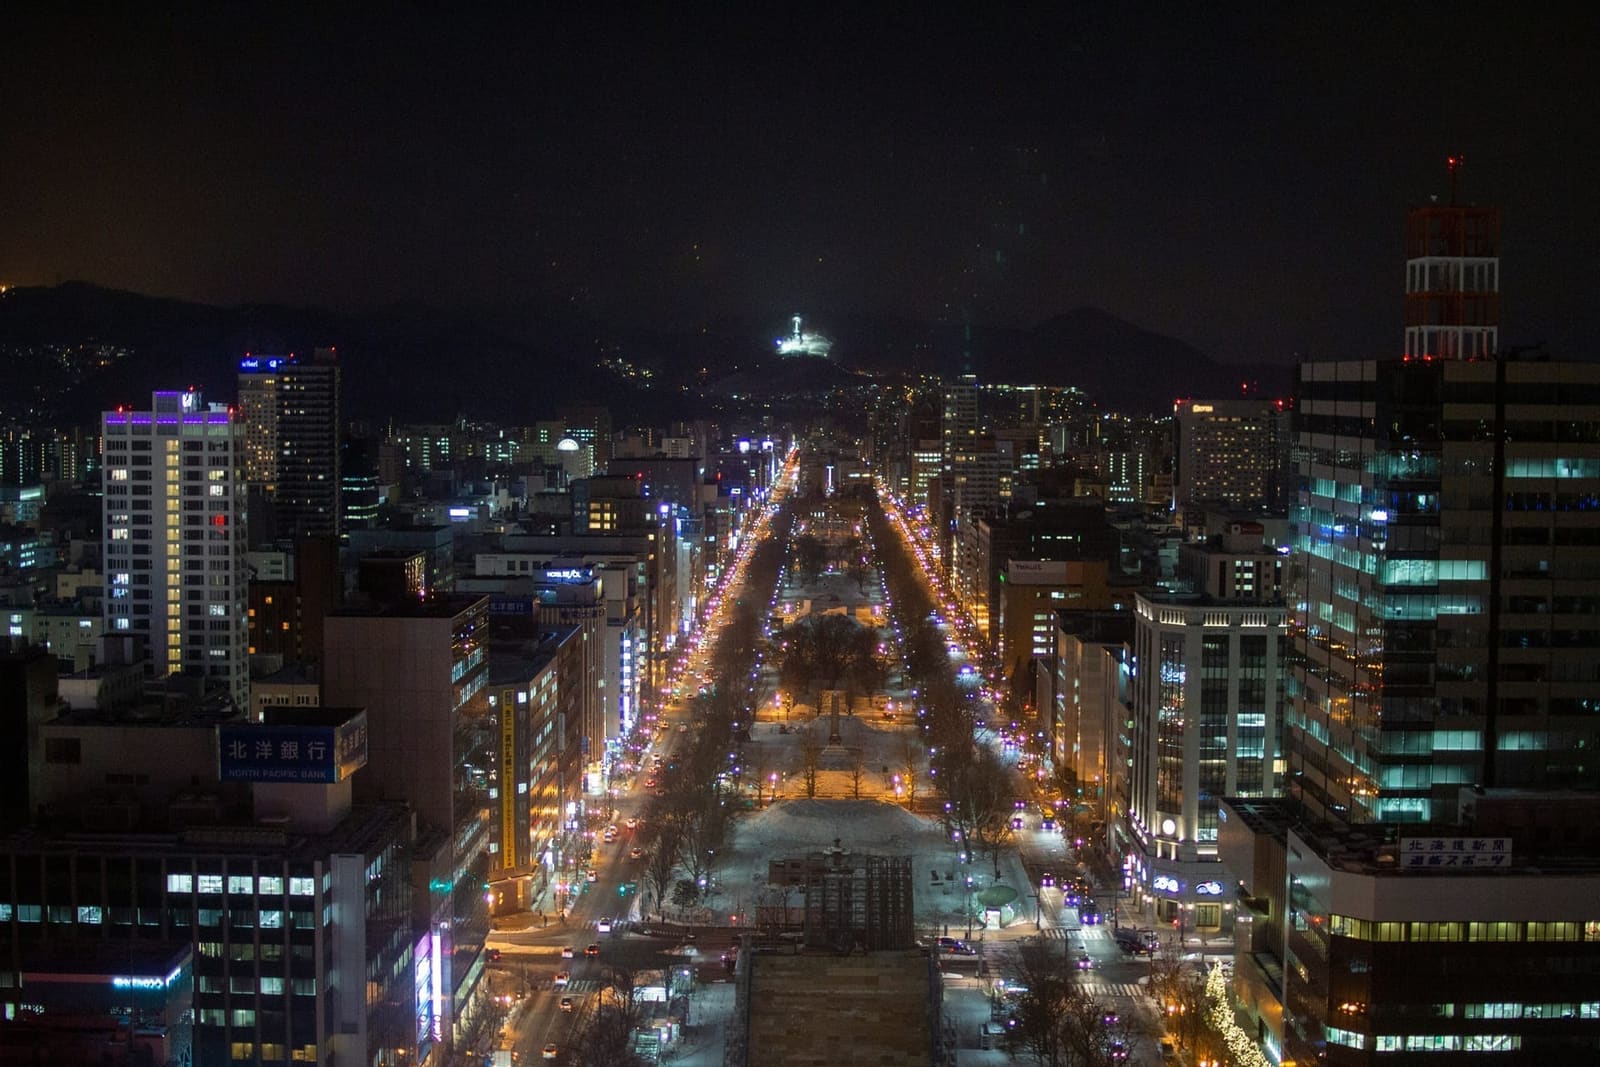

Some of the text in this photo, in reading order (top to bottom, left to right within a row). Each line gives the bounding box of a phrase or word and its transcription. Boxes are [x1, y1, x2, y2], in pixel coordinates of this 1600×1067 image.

[228, 740, 326, 760] 北洋銀行
[228, 767, 326, 779] NORTH PACIFIC BANK
[1409, 840, 1504, 851] 北海道新聞
